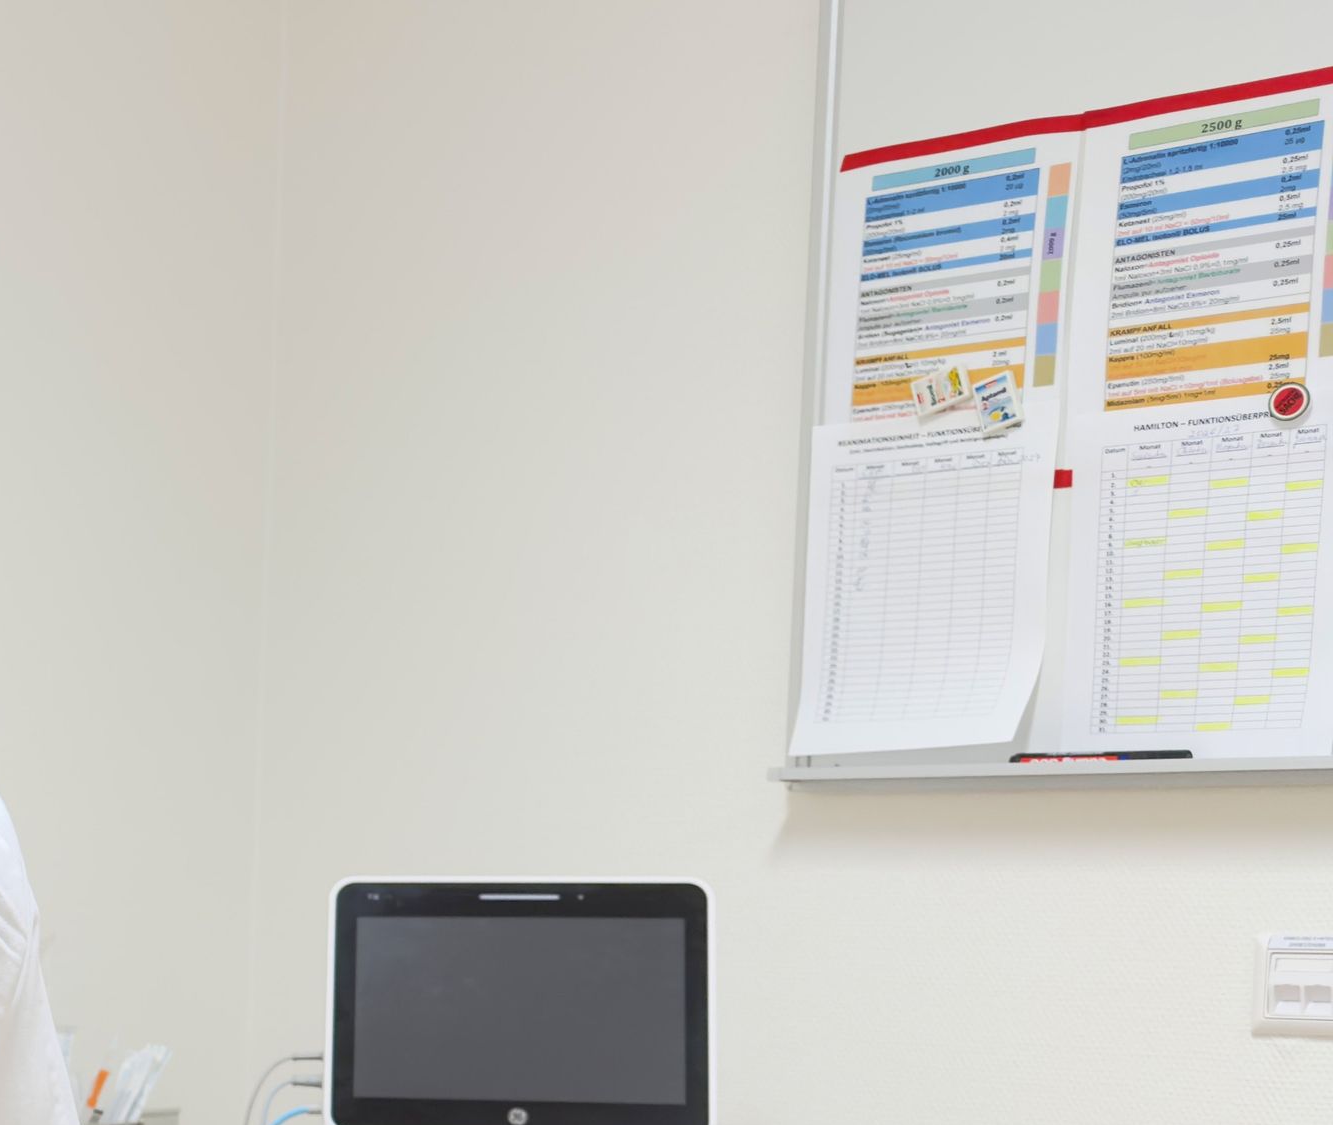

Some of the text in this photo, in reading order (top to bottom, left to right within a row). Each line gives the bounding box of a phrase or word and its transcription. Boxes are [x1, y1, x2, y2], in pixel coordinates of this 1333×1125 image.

[1201, 119, 1243, 134] 2500 g
[934, 164, 970, 178] 2000 g
[1115, 250, 1176, 264] ANTAGONISTEN
[1133, 421, 1179, 432] HAMILTON
